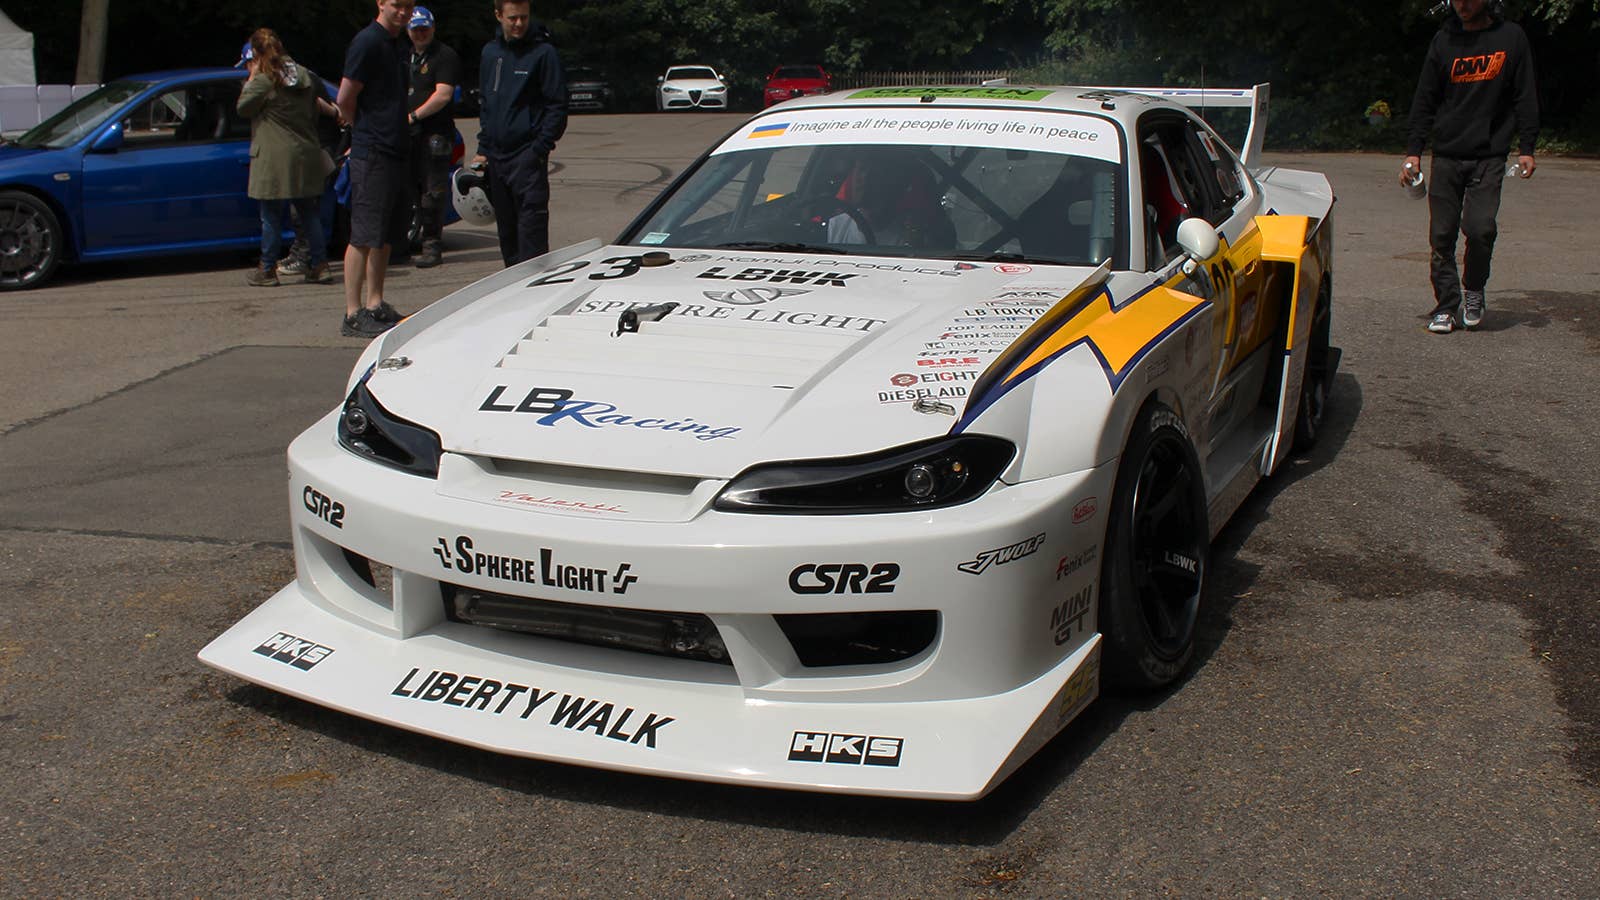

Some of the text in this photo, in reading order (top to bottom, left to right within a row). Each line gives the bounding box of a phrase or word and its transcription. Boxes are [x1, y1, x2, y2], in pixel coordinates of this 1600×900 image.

[790, 118, 1099, 142] Imagine all the people living life in peace
[526, 256, 641, 288] 23
[696, 266, 858, 287] LBWK
[740, 311, 887, 333] LIGHT
[965, 309, 985, 317] LB
[921, 371, 978, 383] EIGHT
[478, 385, 742, 441] LB Racing
[303, 486, 345, 529] CSR2
[456, 535, 608, 592] SPHERE LIGHT
[788, 563, 900, 594] CSR2
[1164, 552, 1197, 573] LBWK
[1050, 584, 1093, 630] MINI
[252, 631, 336, 672] HKS
[391, 668, 676, 749] LIBERTY WALK
[787, 731, 904, 767] HKS
